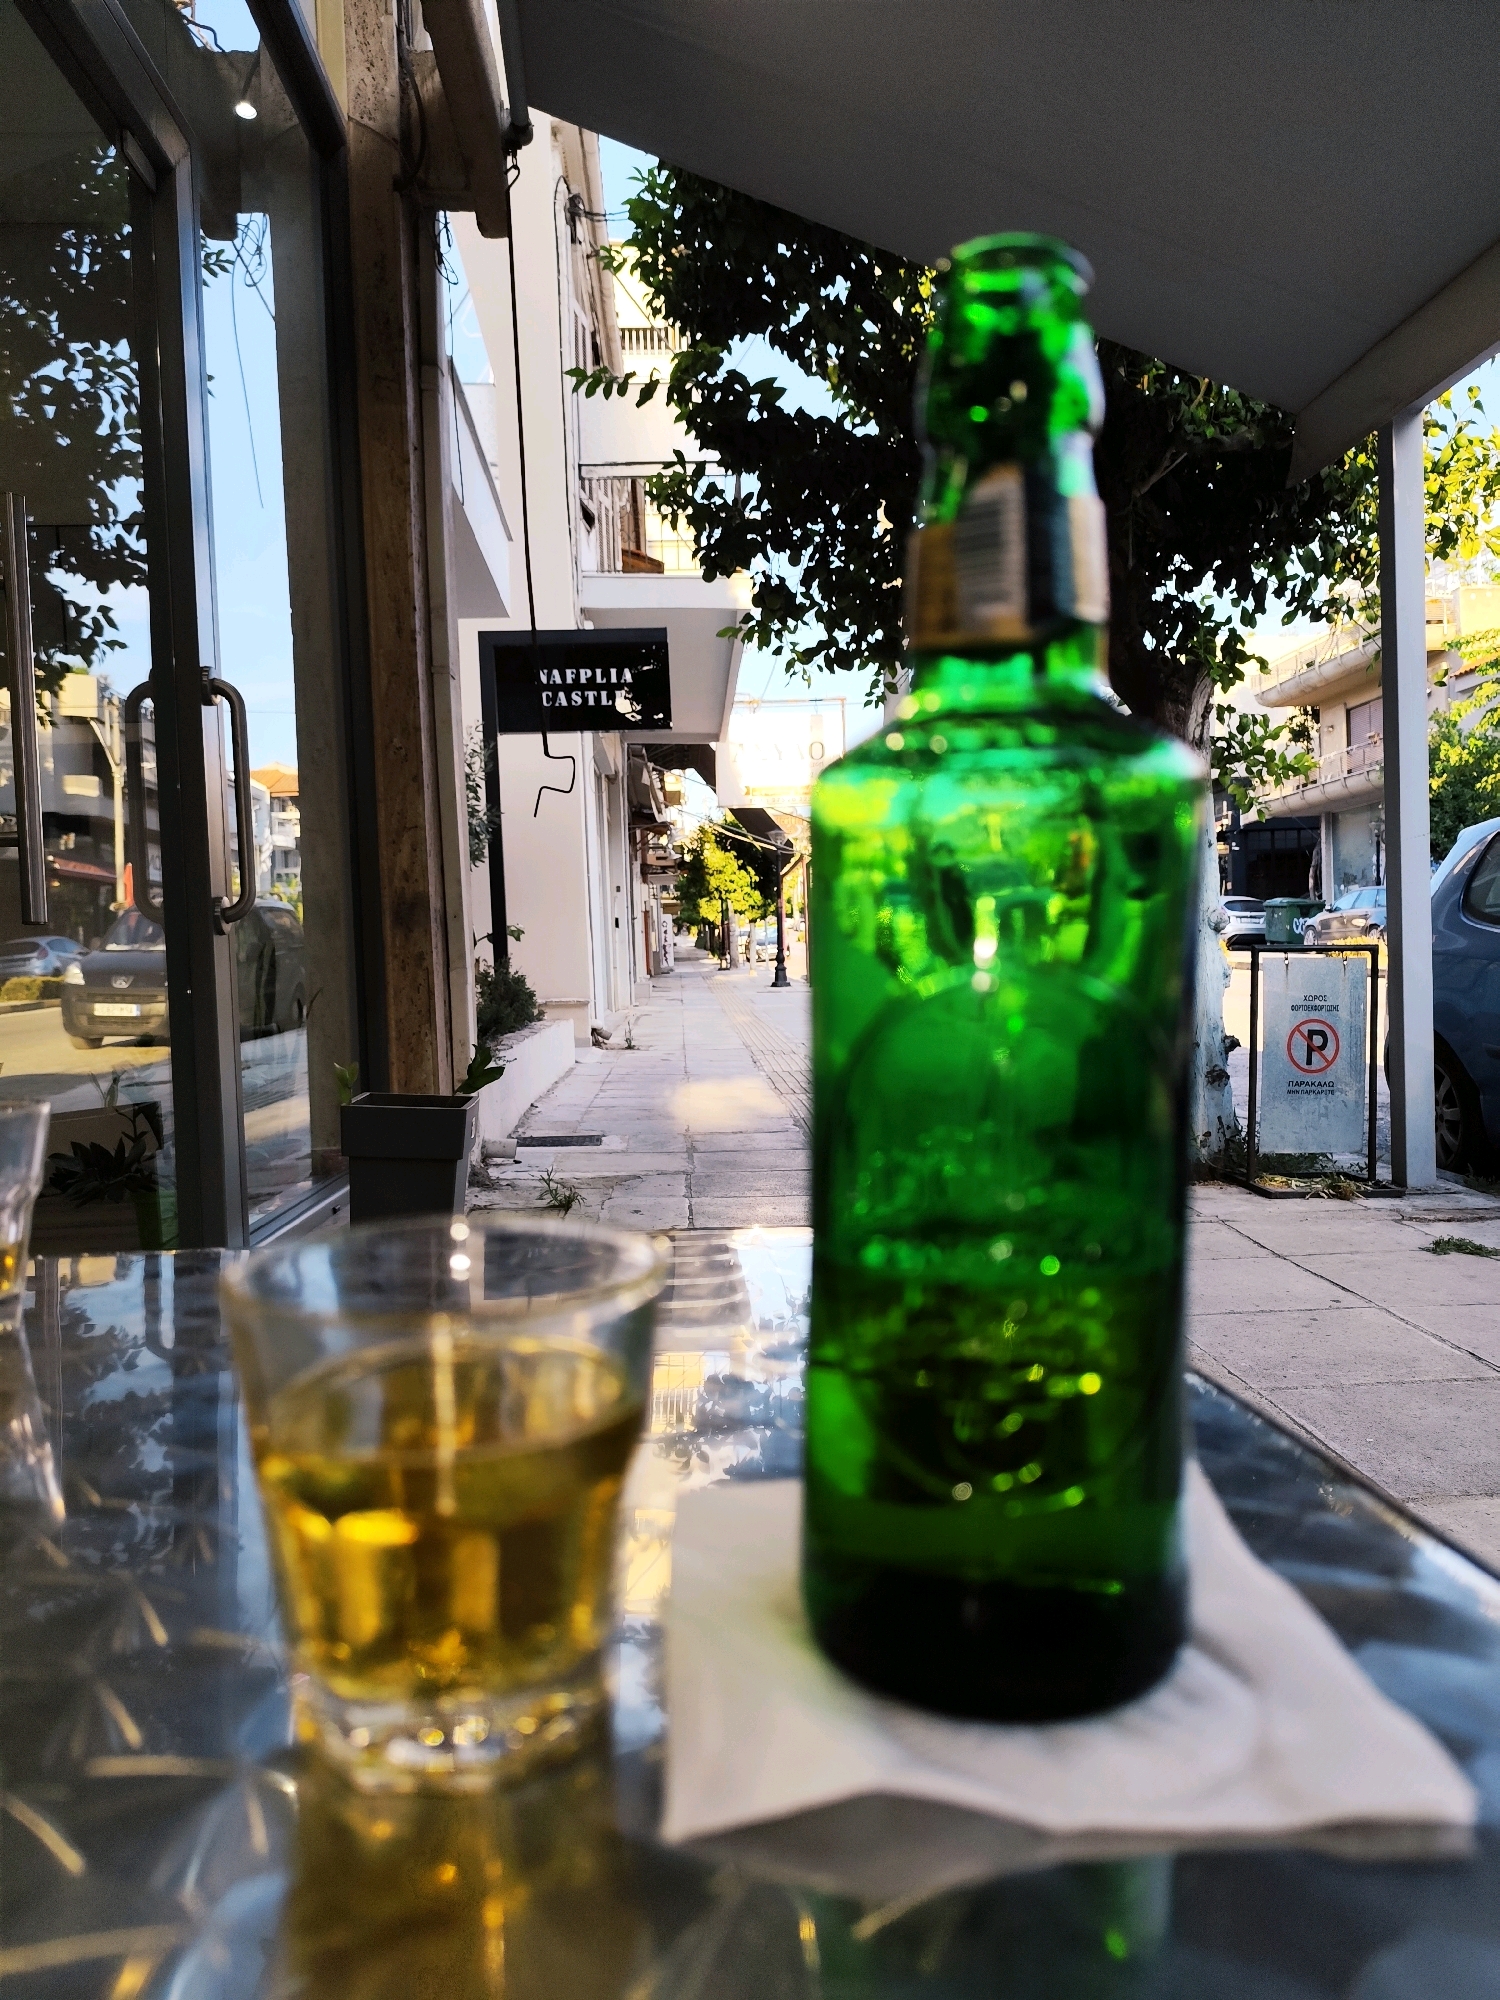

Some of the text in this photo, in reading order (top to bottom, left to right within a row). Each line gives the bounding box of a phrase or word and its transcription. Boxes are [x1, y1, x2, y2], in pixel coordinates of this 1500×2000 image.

[535, 668, 633, 684] NAFPLIA
[1303, 994, 1328, 1002] ΧΩΡΟΣ
[1288, 1080, 1335, 1088] ΠΑΡΑΚΑΛΩ
